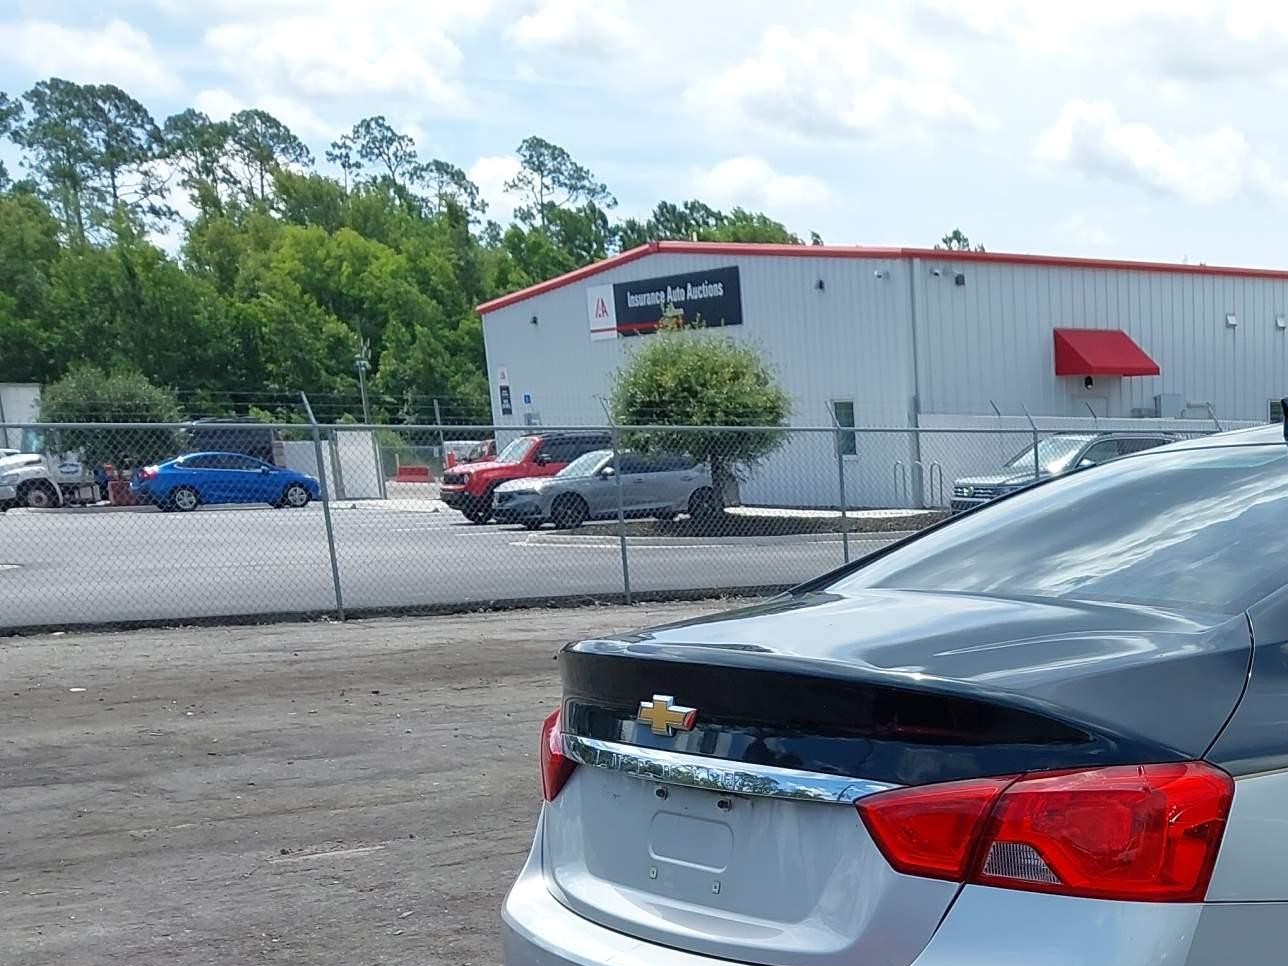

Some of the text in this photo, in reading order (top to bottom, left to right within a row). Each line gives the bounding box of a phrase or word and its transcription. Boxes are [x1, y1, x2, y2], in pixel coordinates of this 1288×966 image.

[627, 279, 724, 308] Insurance Auto Auctions
